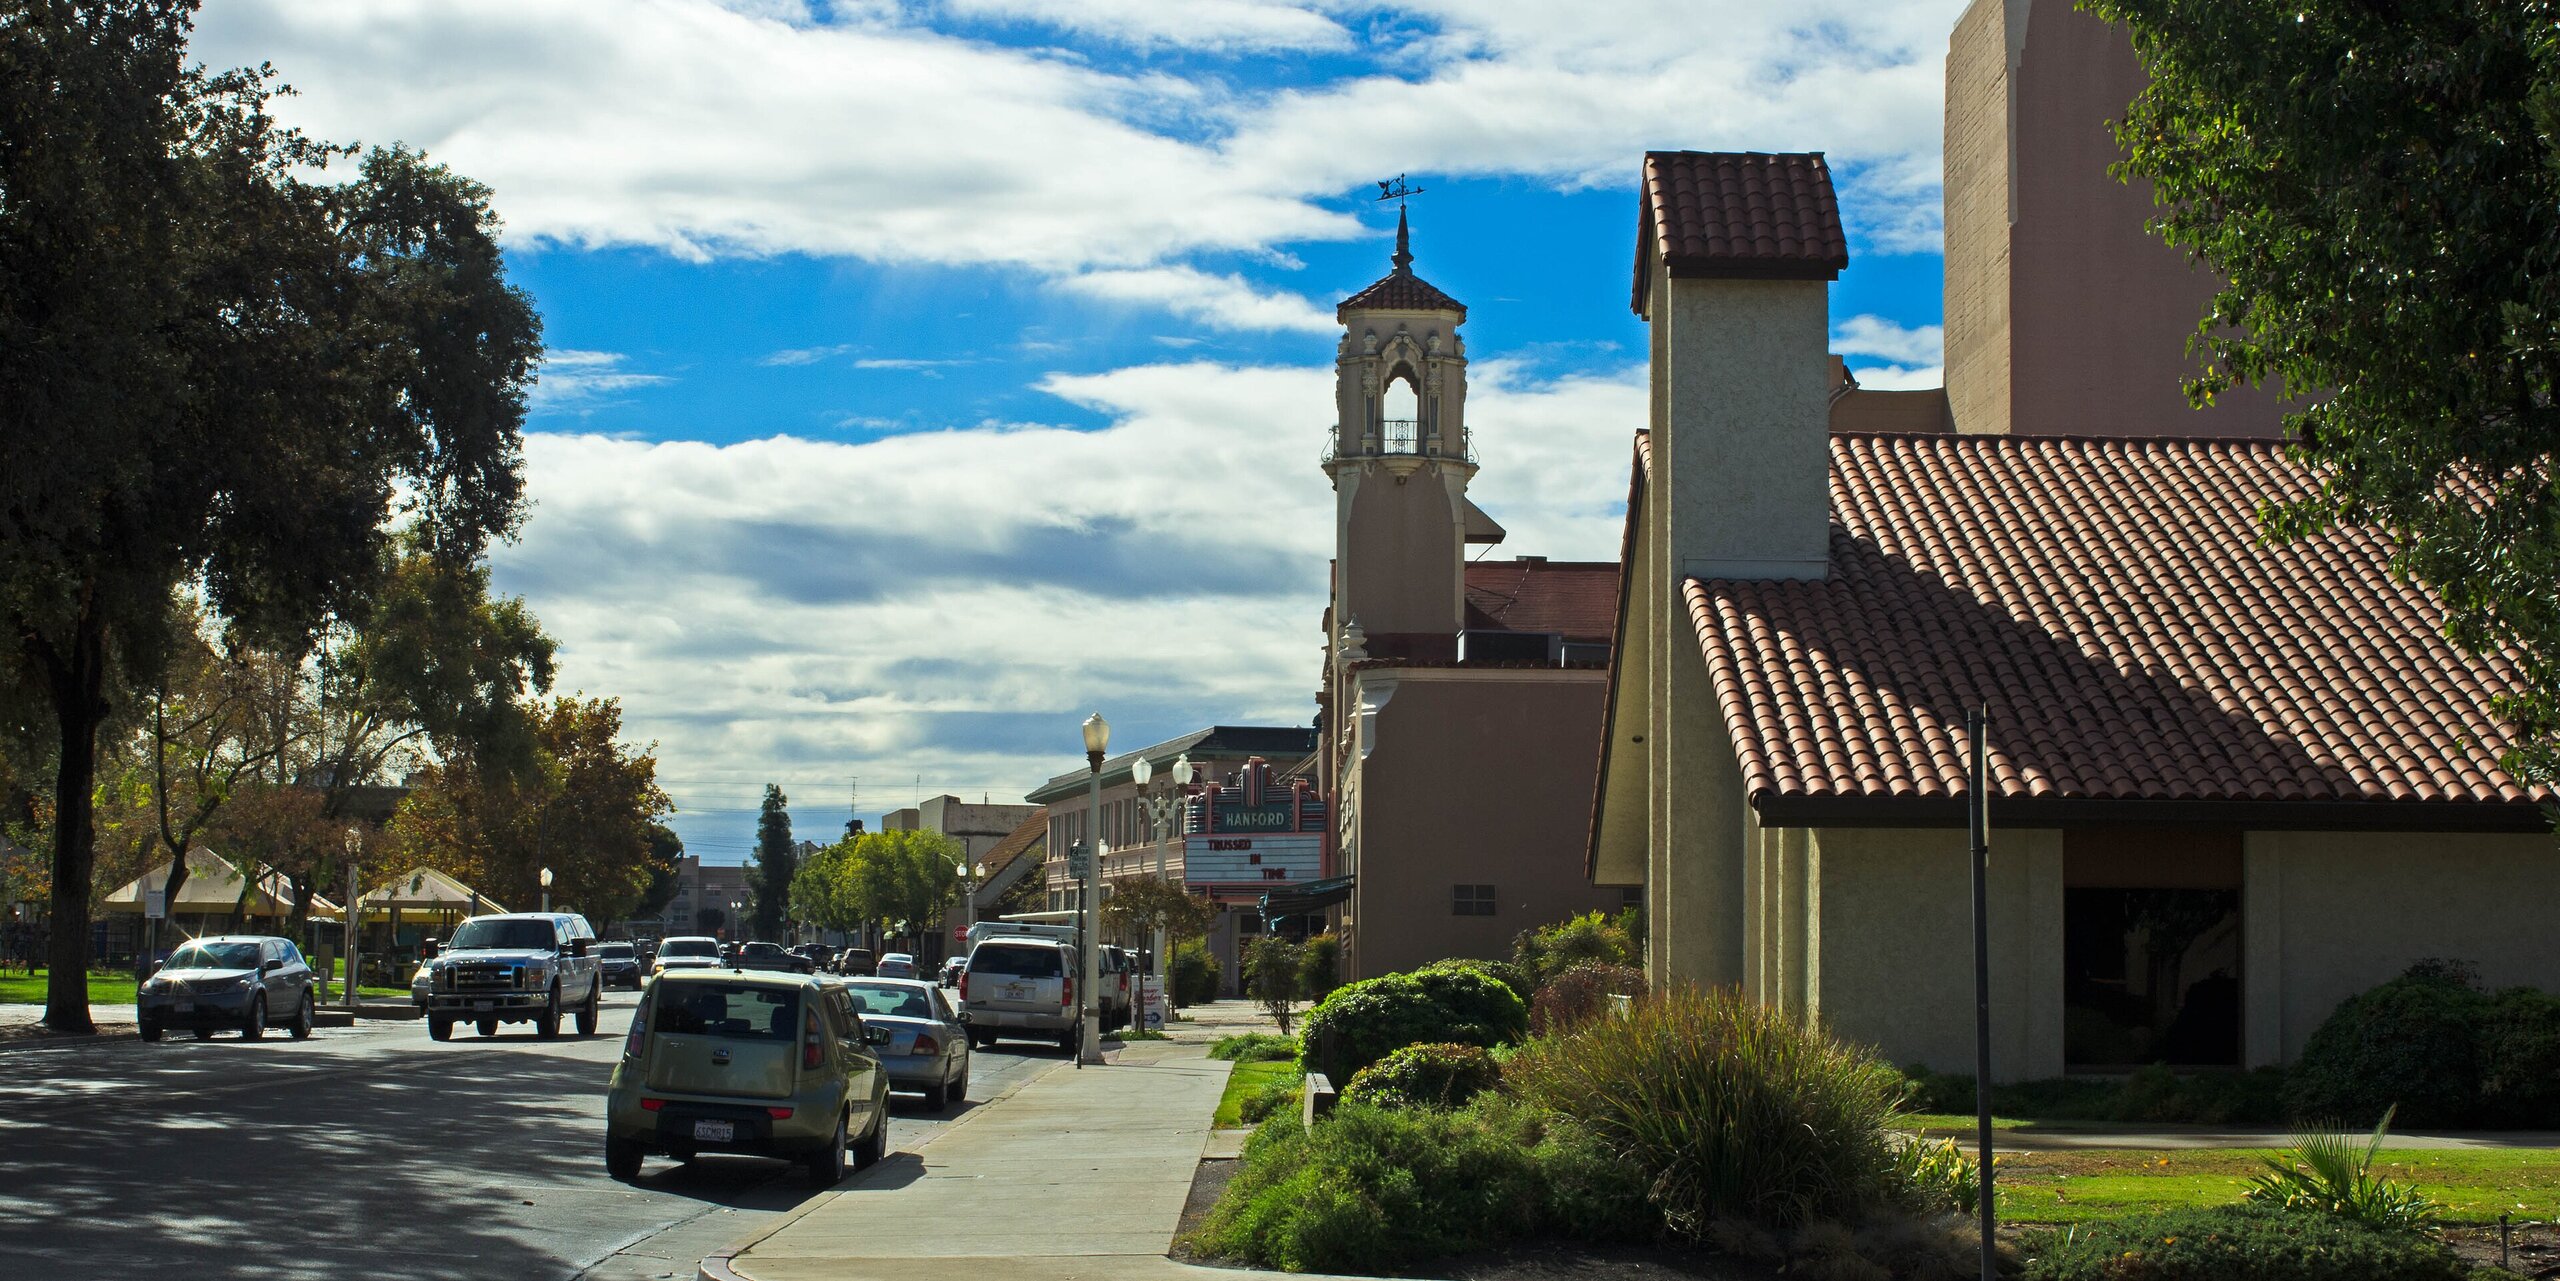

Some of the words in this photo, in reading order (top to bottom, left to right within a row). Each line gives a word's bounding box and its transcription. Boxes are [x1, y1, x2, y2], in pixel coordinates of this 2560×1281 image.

[1226, 812, 1284, 827] HANFORD
[1207, 839, 1252, 851] TRUSSED
[1250, 853, 1261, 865] IN
[1261, 868, 1287, 880] TIME
